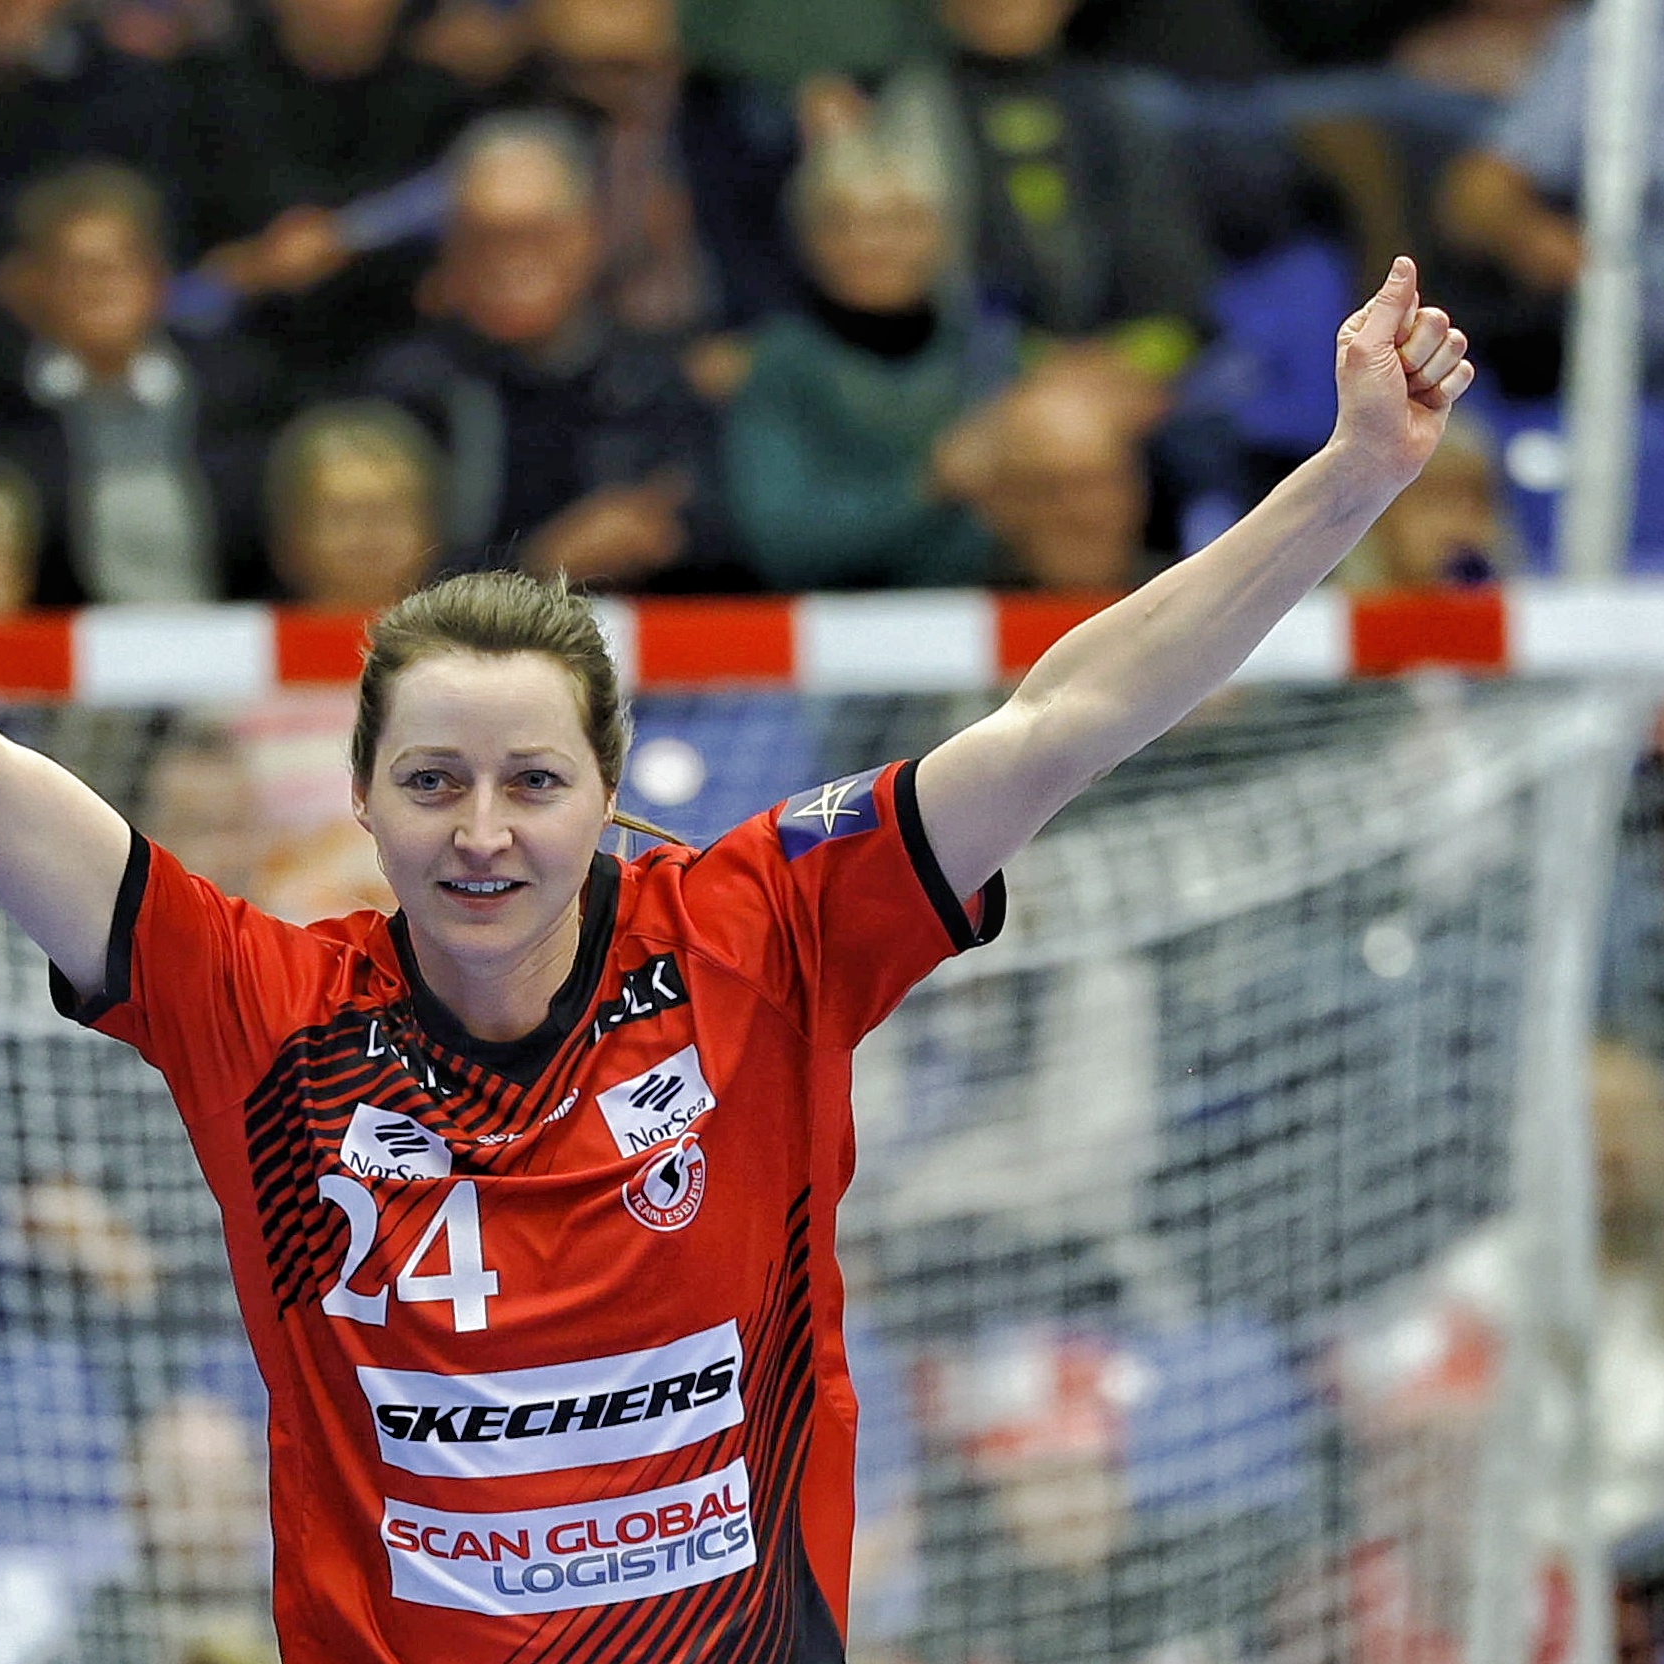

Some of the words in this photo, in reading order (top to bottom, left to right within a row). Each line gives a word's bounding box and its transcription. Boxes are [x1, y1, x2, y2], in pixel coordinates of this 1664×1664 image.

[624, 1097, 707, 1153] NorSea
[350, 1151, 443, 1180] NorSe
[631, 1192, 662, 1224] TEAM
[665, 1167, 703, 1224] ESBJERG
[317, 1173, 500, 1334] 24
[376, 1356, 736, 1443] SKECHERS
[386, 1518, 529, 1563] SCAN
[545, 1485, 747, 1556] GLOBAL
[493, 1517, 750, 1595] LOGISTICS
